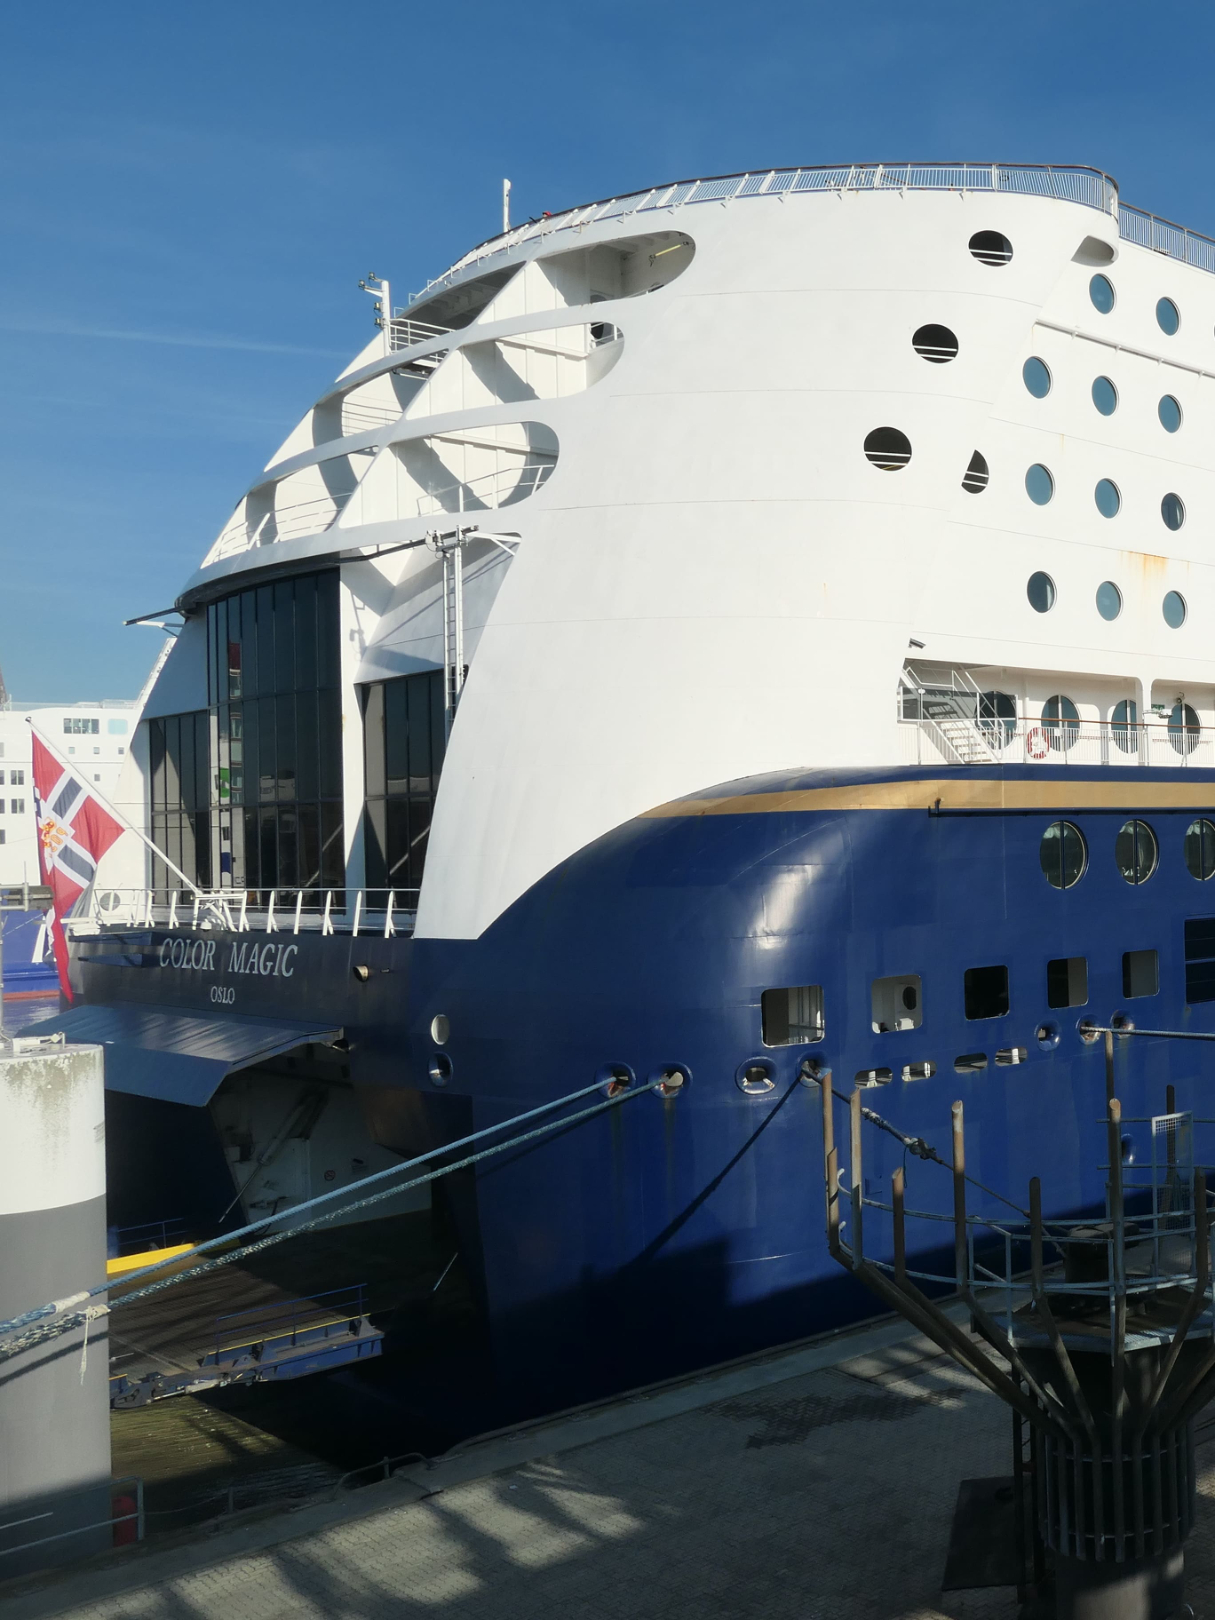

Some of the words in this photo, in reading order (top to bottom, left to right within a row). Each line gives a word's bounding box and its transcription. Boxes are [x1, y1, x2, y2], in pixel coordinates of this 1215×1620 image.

[159, 937, 217, 971] COLOR
[227, 941, 299, 978] MAGIC
[210, 985, 236, 1005] OSLO
